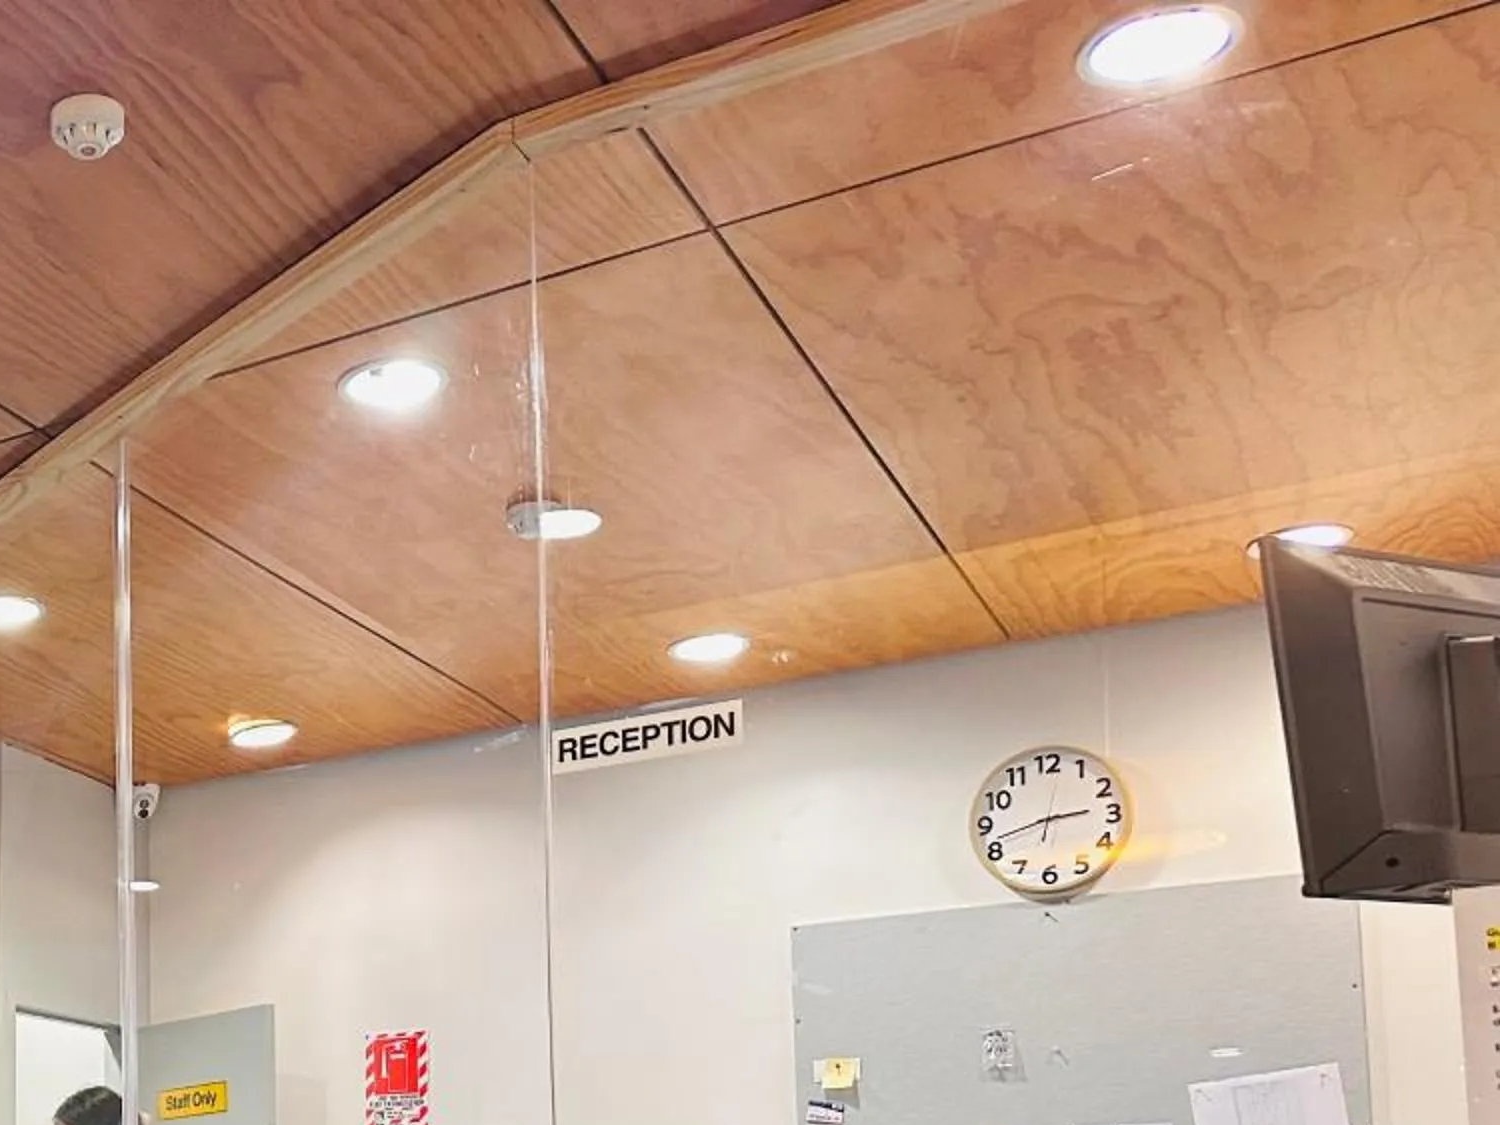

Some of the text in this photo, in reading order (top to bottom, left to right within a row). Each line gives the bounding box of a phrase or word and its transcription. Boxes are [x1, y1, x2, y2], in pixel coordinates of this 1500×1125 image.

[558, 711, 735, 763] RECEPTION
[1034, 753, 1061, 774] 12
[1075, 759, 1085, 778] 1
[1006, 766, 1026, 786] 11
[1096, 777, 1112, 798] 2
[985, 790, 1012, 810] 10
[1105, 803, 1122, 823] 3
[977, 816, 993, 836] 9
[1095, 831, 1114, 850] 4
[987, 841, 1003, 861] 8
[1012, 859, 1028, 874] 7
[1073, 853, 1089, 874] 5
[1041, 864, 1058, 884] 6
[193, 1089, 217, 1108] Only
